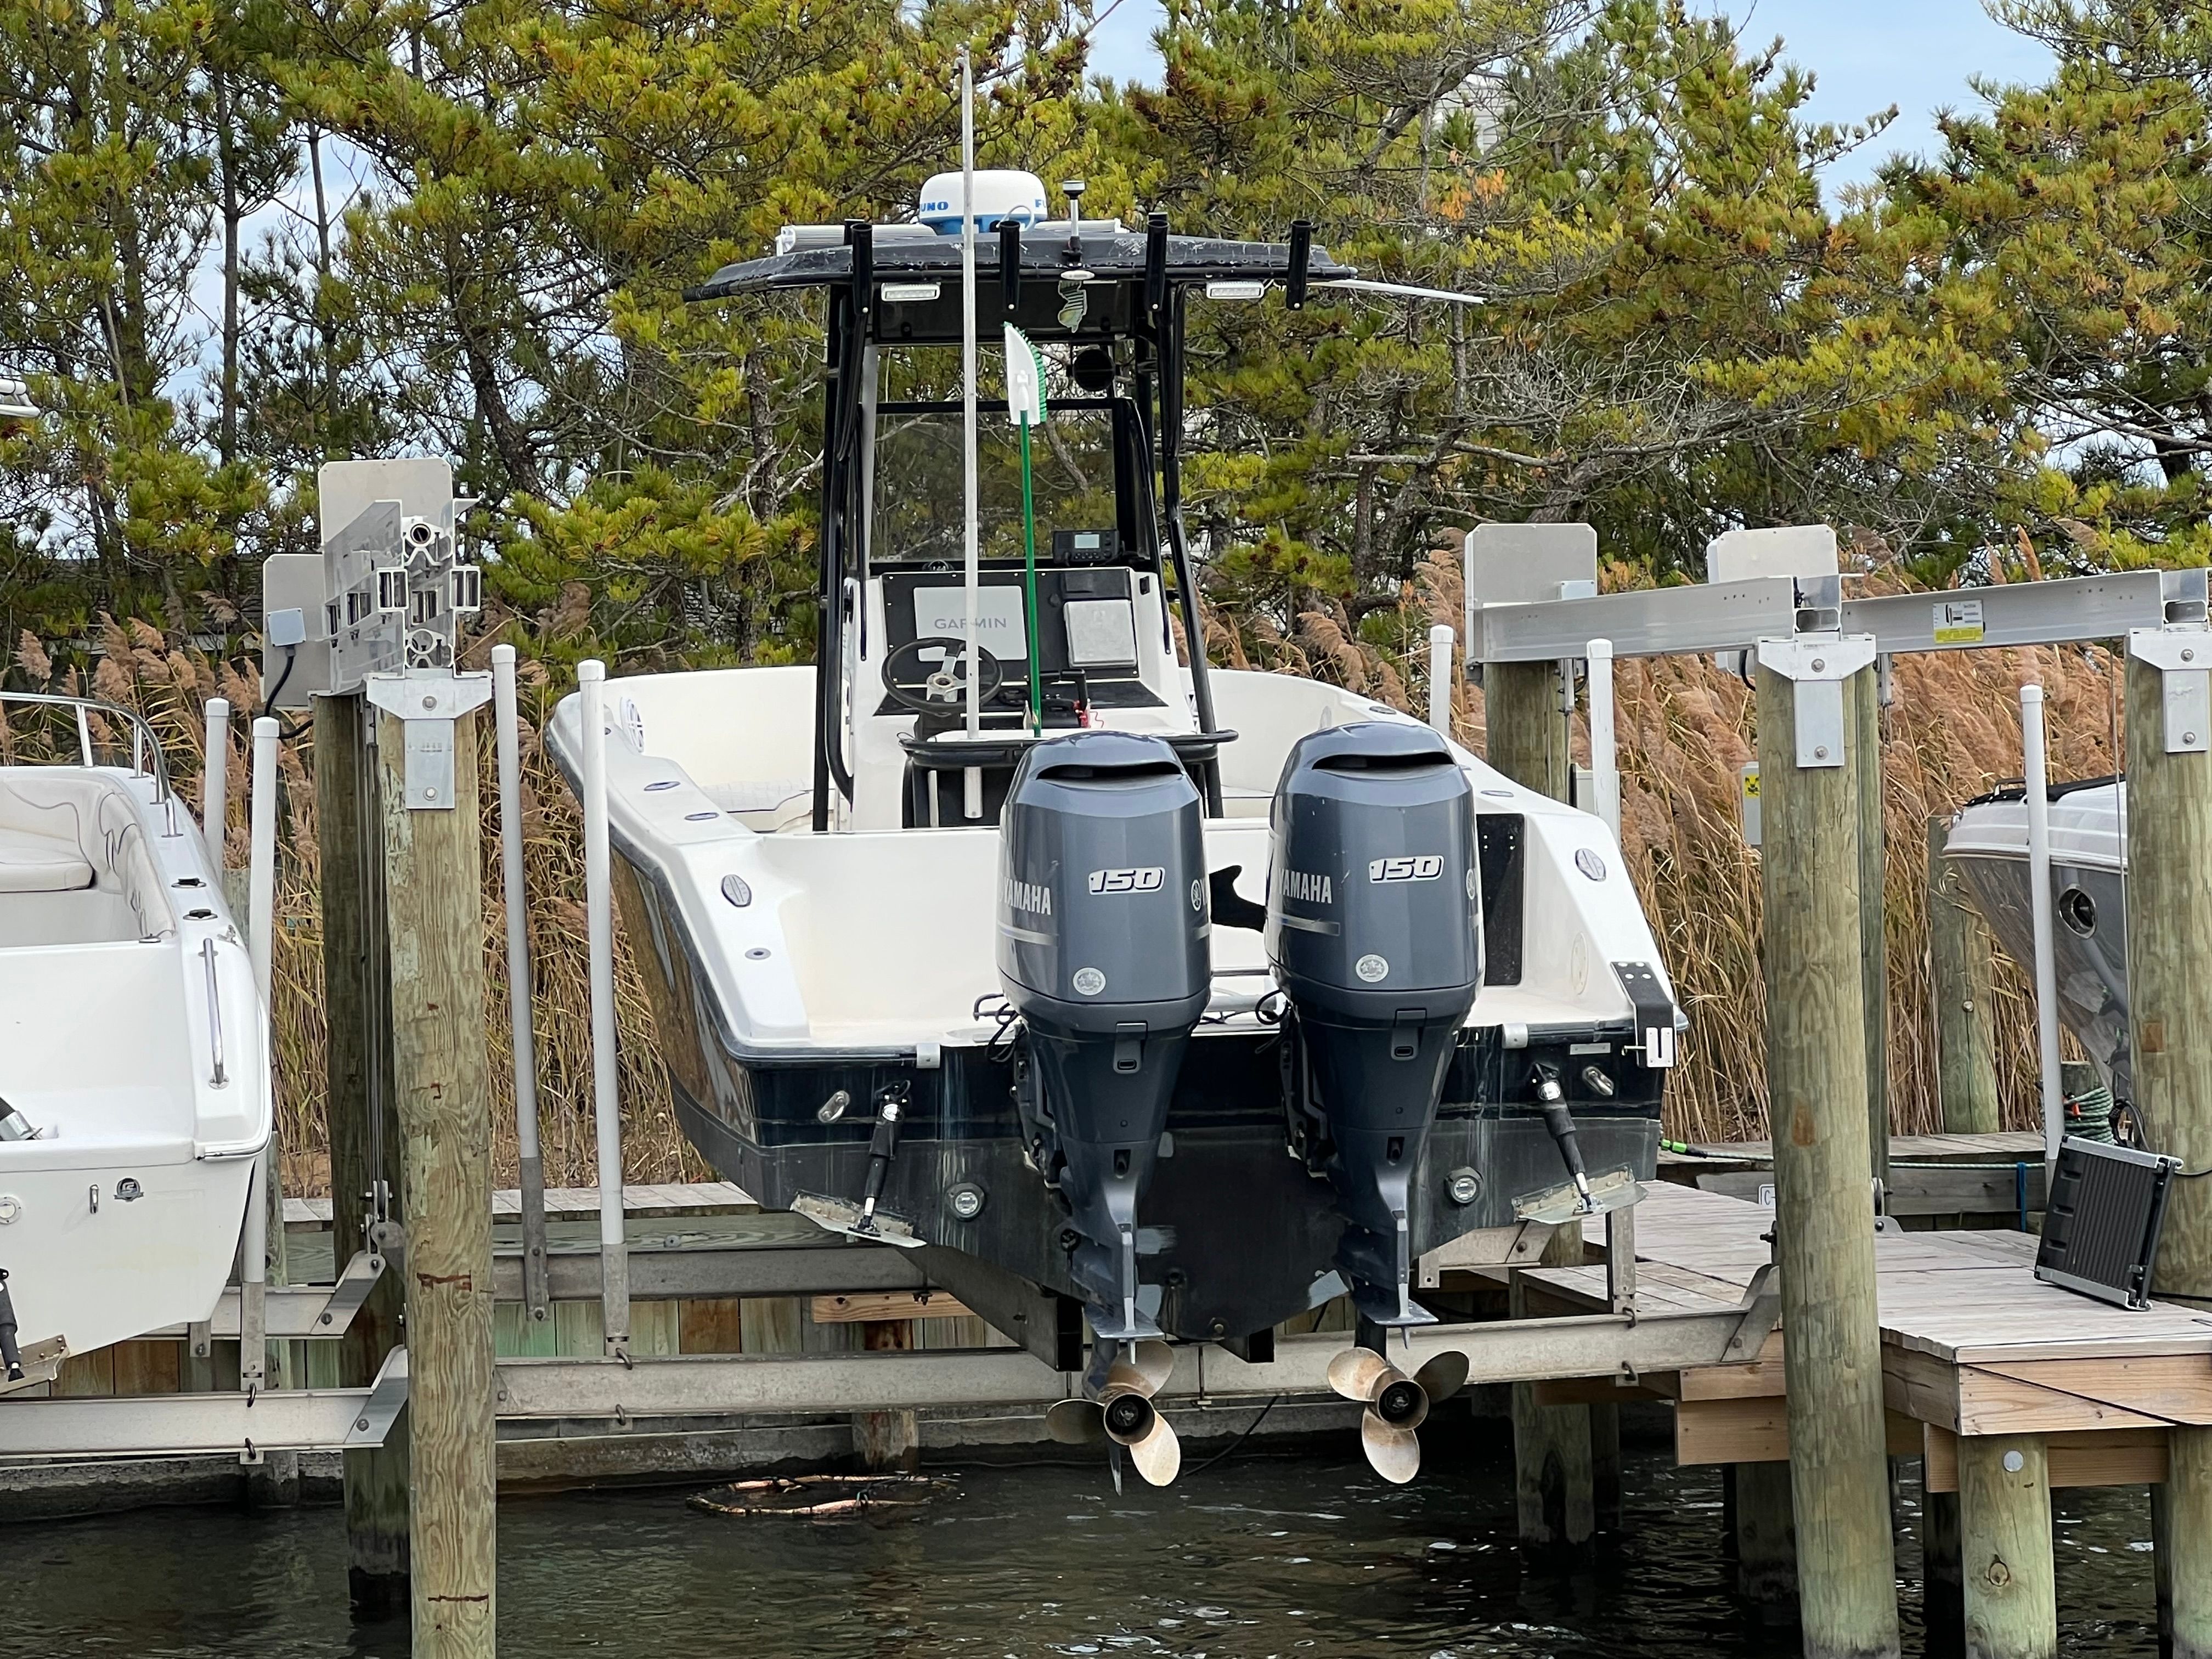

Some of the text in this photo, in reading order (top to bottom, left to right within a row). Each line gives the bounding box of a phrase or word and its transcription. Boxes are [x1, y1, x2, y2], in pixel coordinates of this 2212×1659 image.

[1090, 868, 1163, 893] 150
[1370, 857, 1442, 881] 150
[1004, 876, 1051, 916] YAMAHA
[1278, 867, 1332, 904] YAMAHA
